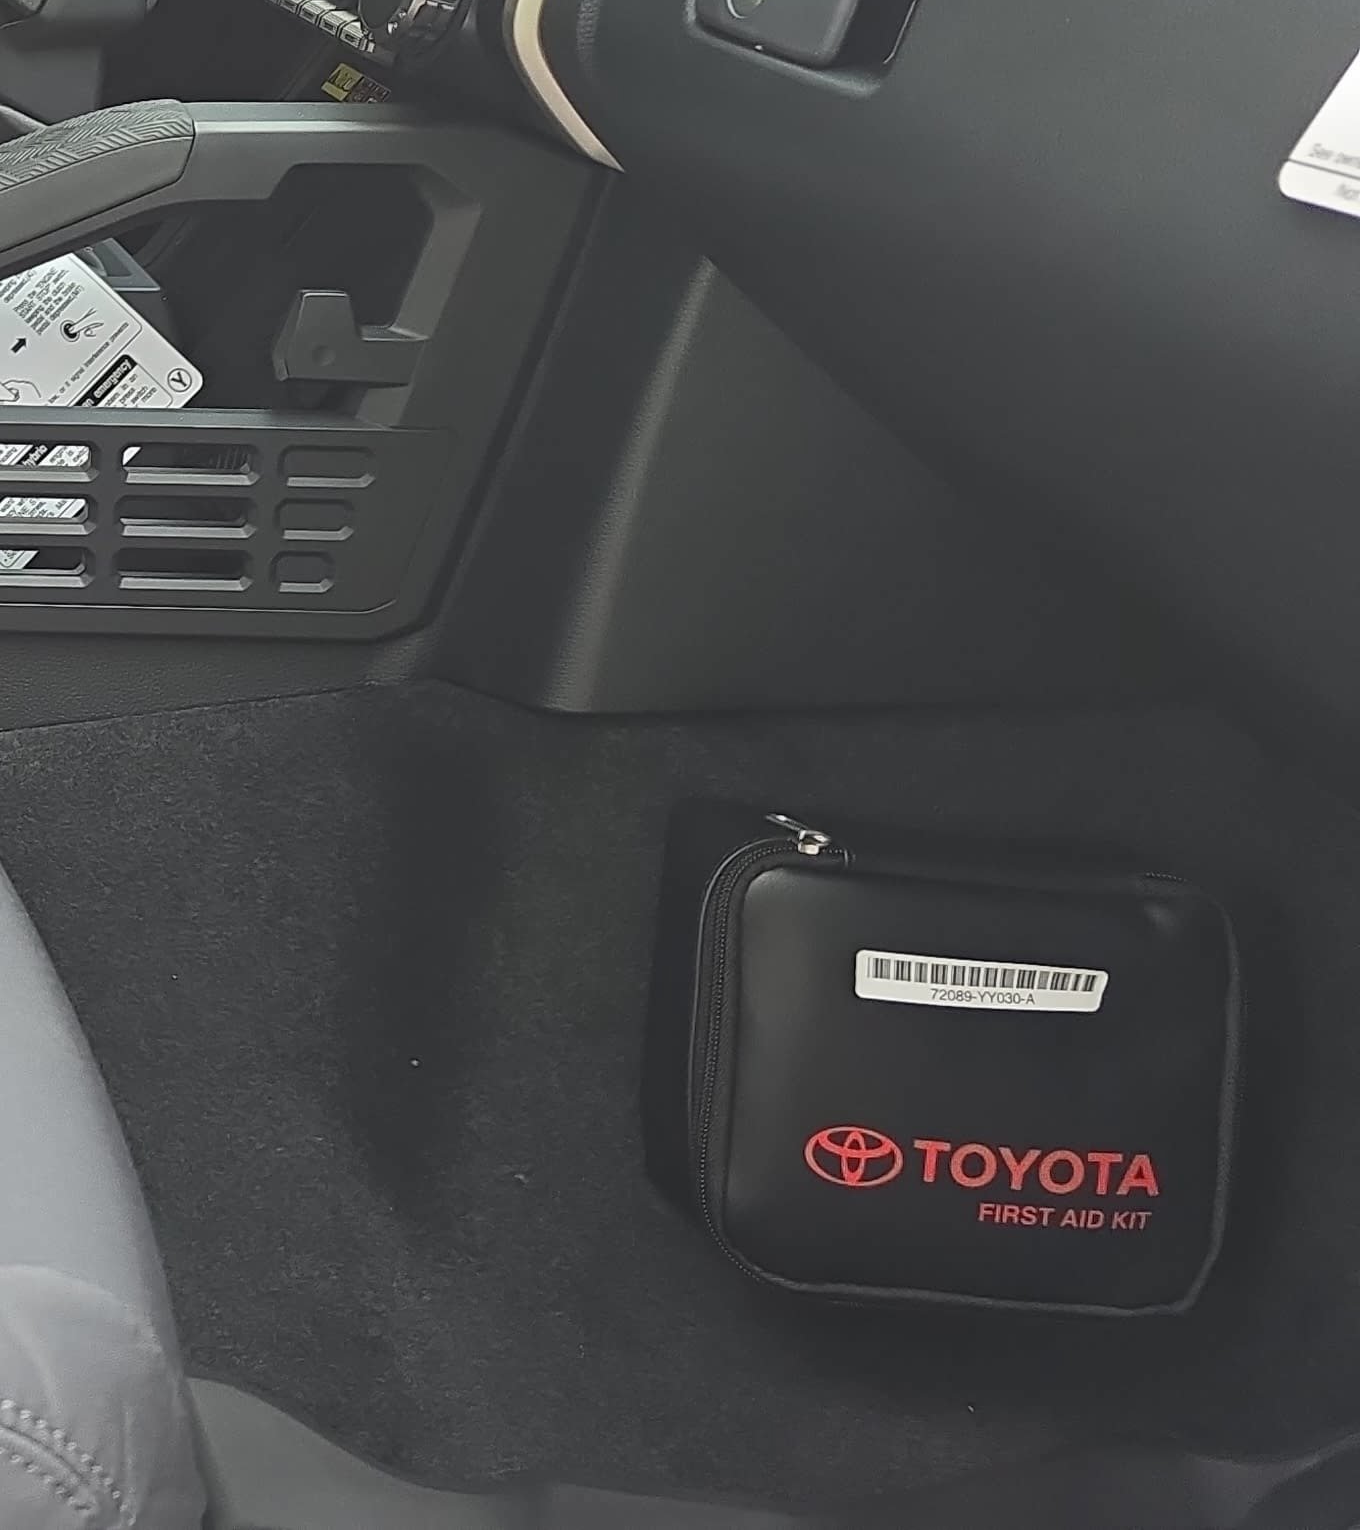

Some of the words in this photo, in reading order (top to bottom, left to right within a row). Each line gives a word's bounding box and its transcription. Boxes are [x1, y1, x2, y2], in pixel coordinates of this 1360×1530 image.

[94, 360, 132, 399] emergency
[930, 988, 1035, 1005] 72089-YY030-A
[913, 1138, 1159, 1197] TOYOTA
[978, 1202, 1055, 1227] FIRST
[1060, 1209, 1104, 1229] AID
[1112, 1211, 1152, 1230] KIT
